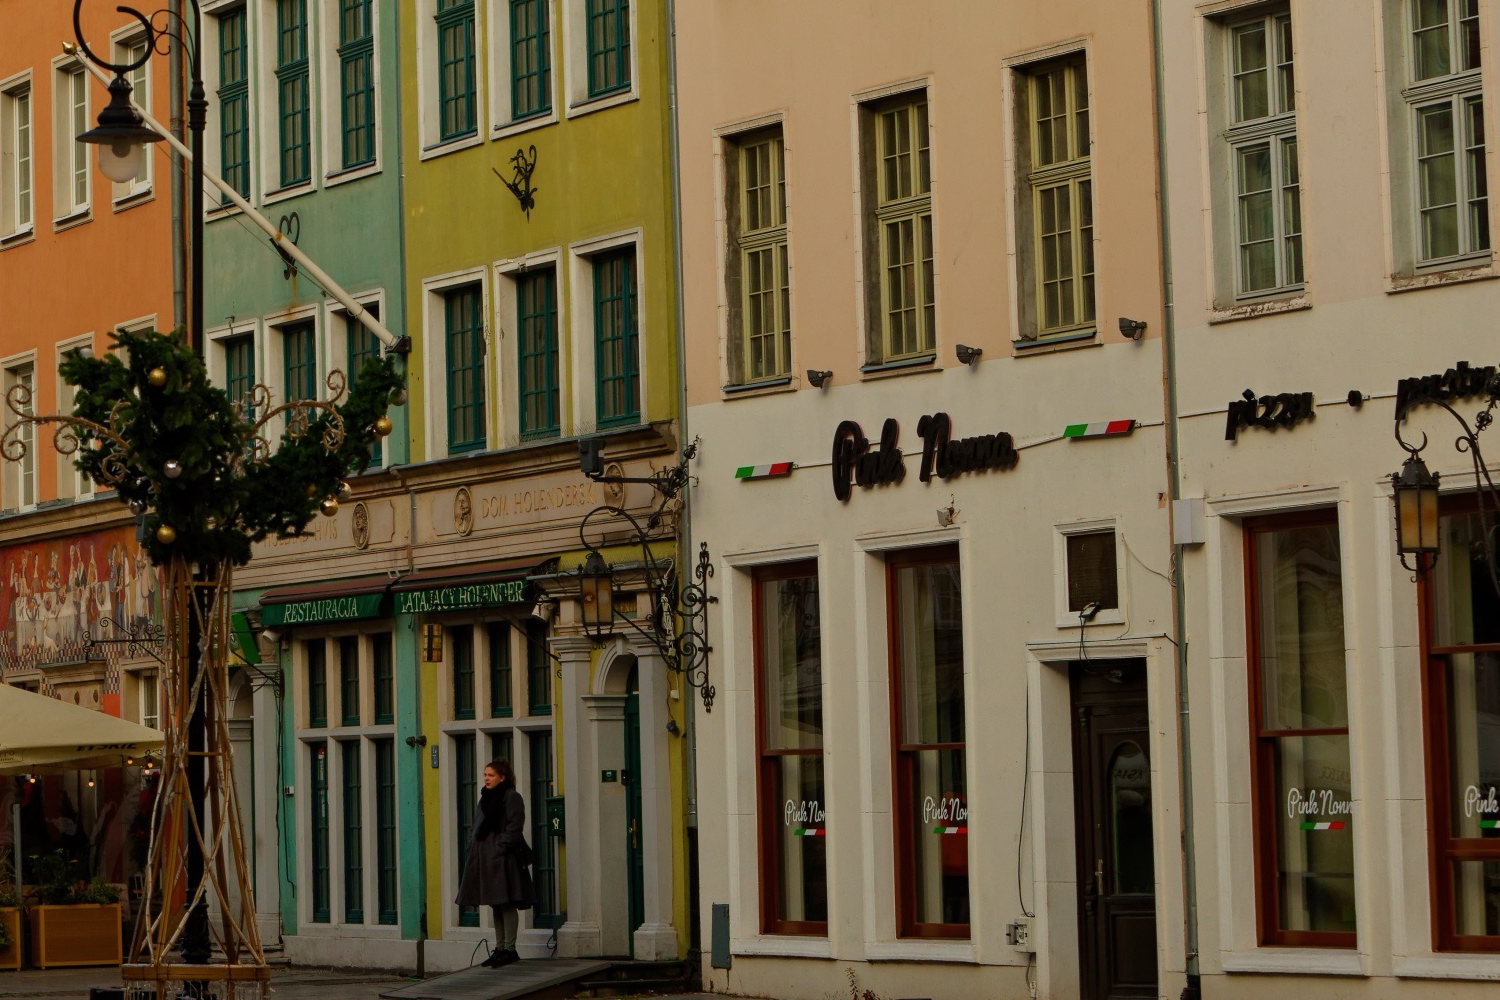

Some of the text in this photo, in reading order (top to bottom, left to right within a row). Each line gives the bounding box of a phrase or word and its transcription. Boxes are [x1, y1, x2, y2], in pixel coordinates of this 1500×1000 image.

[1225, 389, 1315, 440] pizza
[832, 412, 1019, 501] Pink Nonna
[482, 495, 509, 518] DOM
[459, 580, 525, 603] HOLENDER
[283, 597, 359, 623] RESTAURACJA
[784, 800, 808, 826] Pink
[923, 796, 948, 824] Pink
[1287, 788, 1319, 819] Pink
[1465, 785, 1499, 817] Pink
